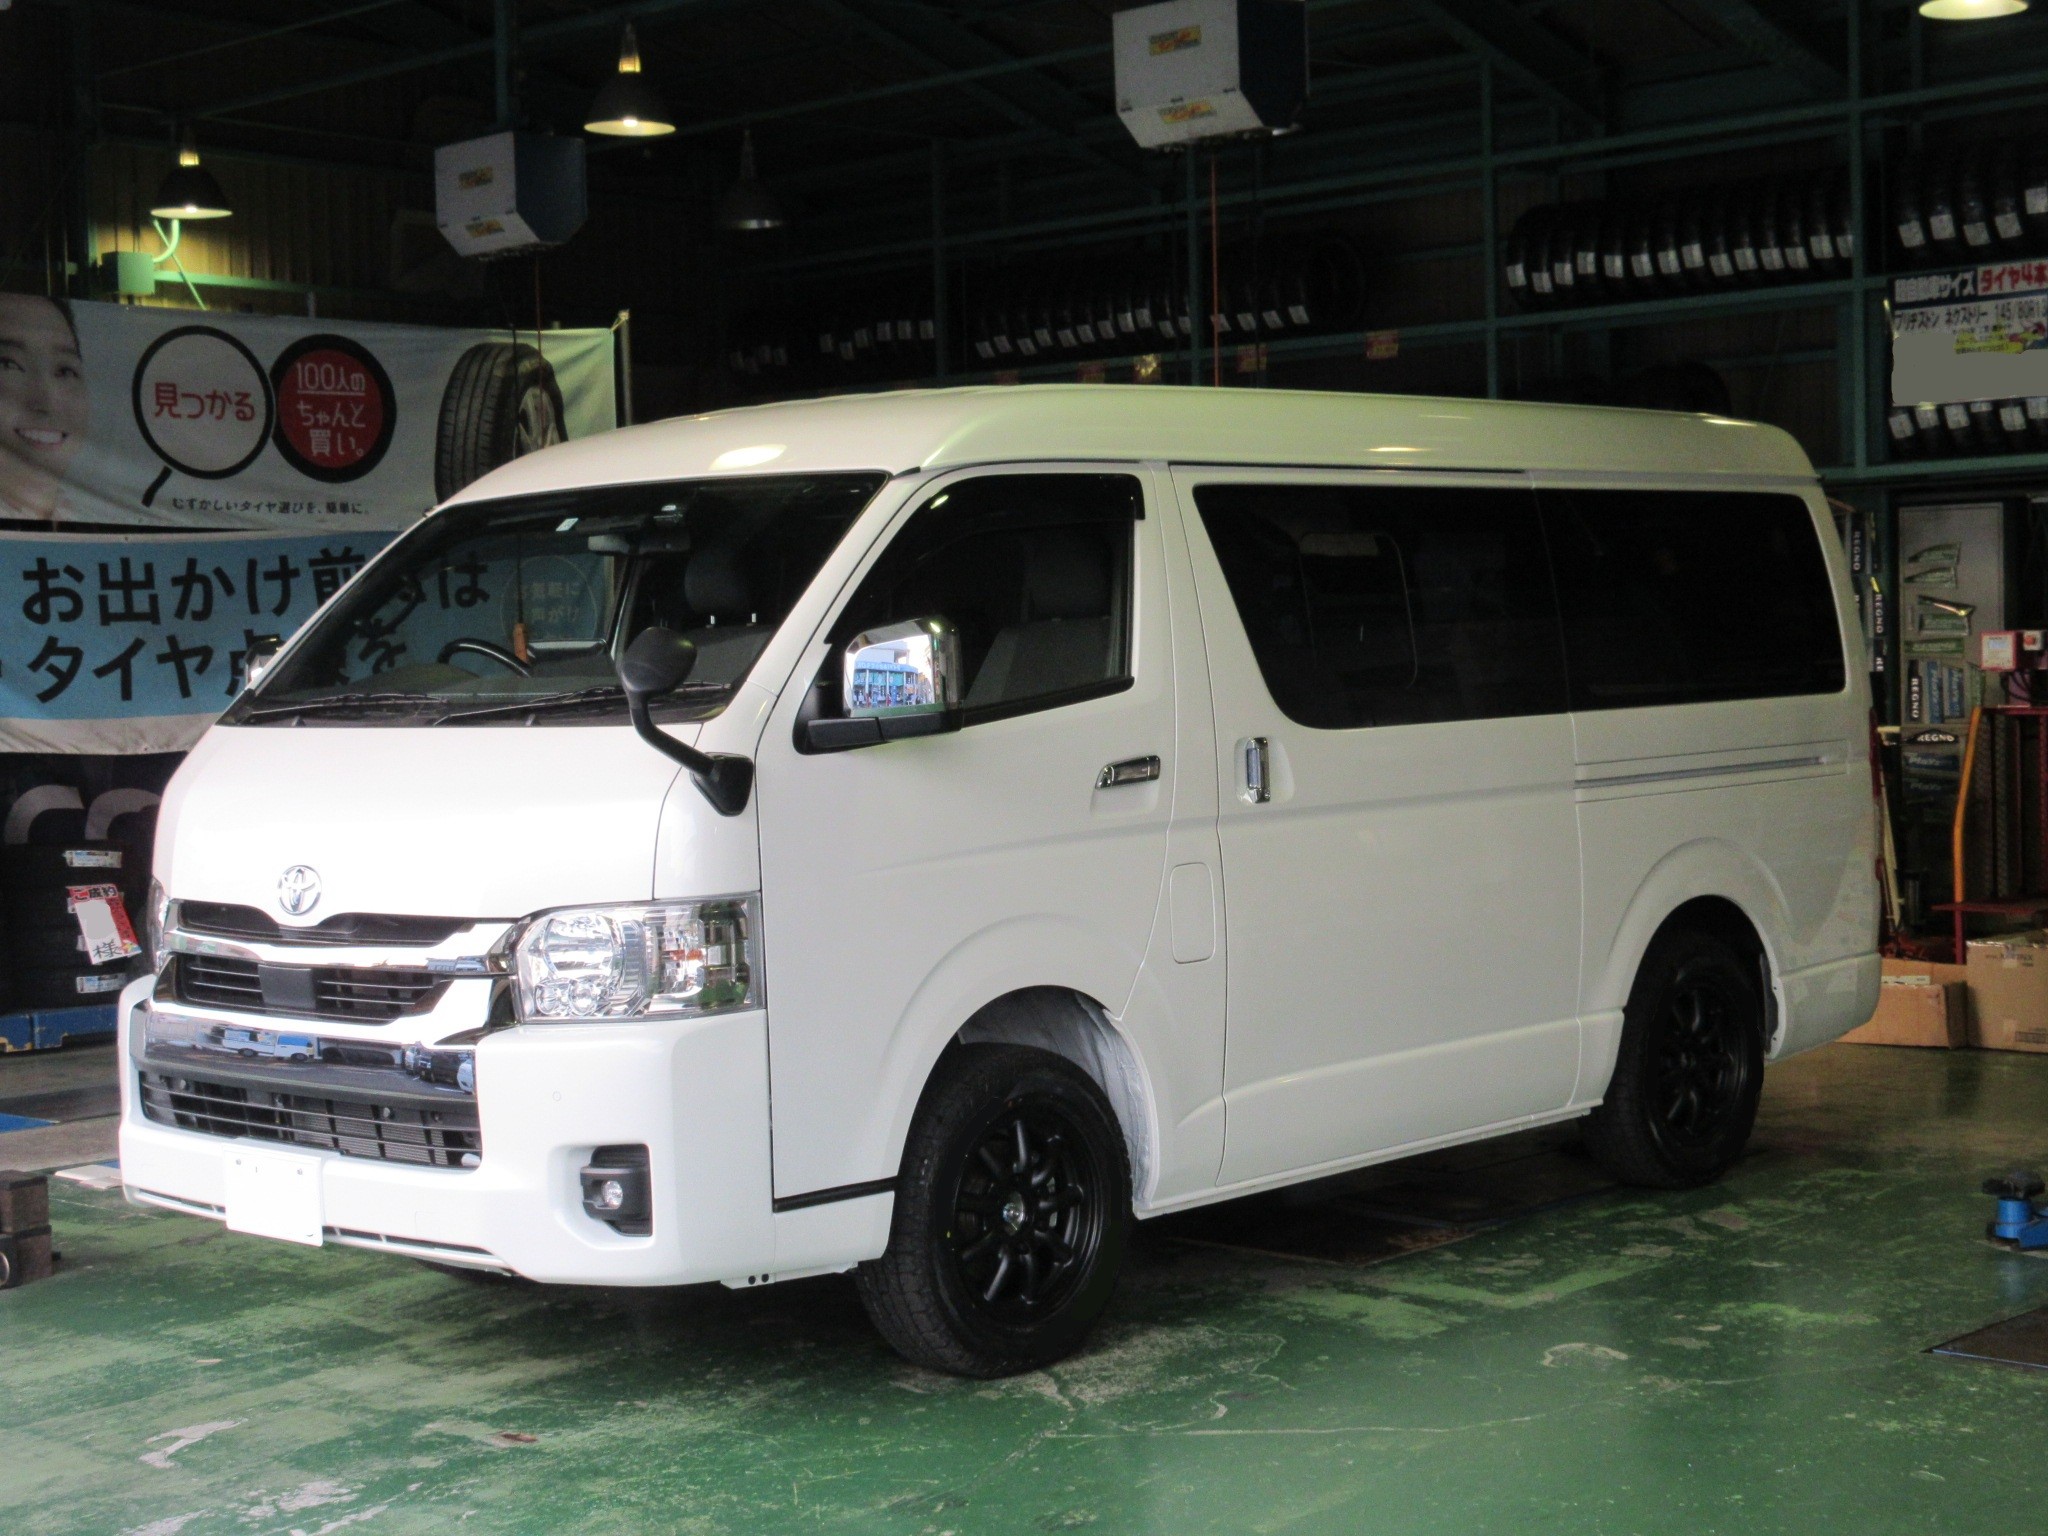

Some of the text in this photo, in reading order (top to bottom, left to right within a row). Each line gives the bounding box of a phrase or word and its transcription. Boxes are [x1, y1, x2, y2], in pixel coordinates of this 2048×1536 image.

[295, 361, 366, 391] 100人の
[154, 382, 256, 422] 見つかる
[296, 400, 367, 429] ちゃんと
[308, 428, 365, 457] 買い。
[22, 544, 490, 628] お出かけ前は
[1874, 593, 1884, 635] REGNO
[1910, 677, 1920, 719] REGNO
[1916, 732, 1955, 743] REGNO
[71, 885, 119, 901] ご成約
[93, 939, 122, 959] 様
